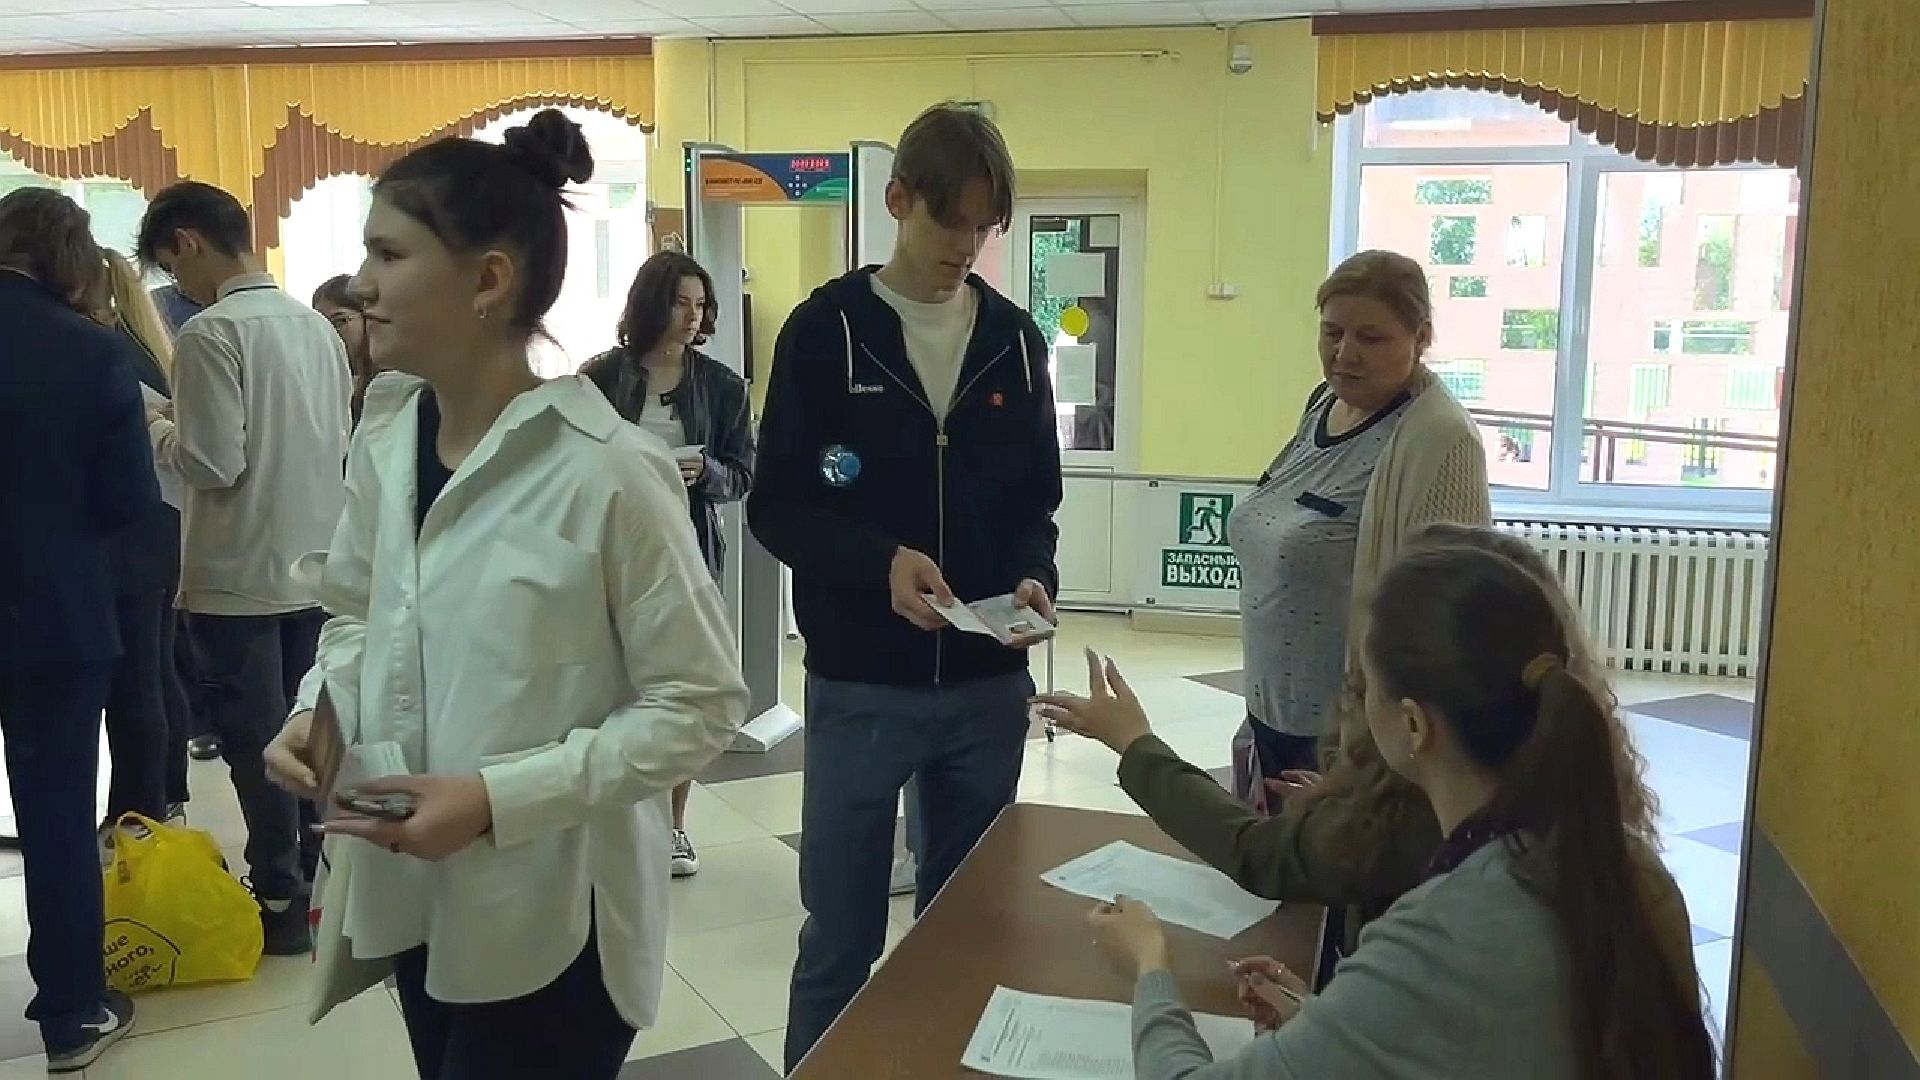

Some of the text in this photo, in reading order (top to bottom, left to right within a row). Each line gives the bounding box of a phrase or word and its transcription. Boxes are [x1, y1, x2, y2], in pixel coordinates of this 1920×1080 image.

[1167, 565, 1241, 589] ВЫХОД
[103, 935, 129, 955] ше
[105, 944, 154, 976] ного,
